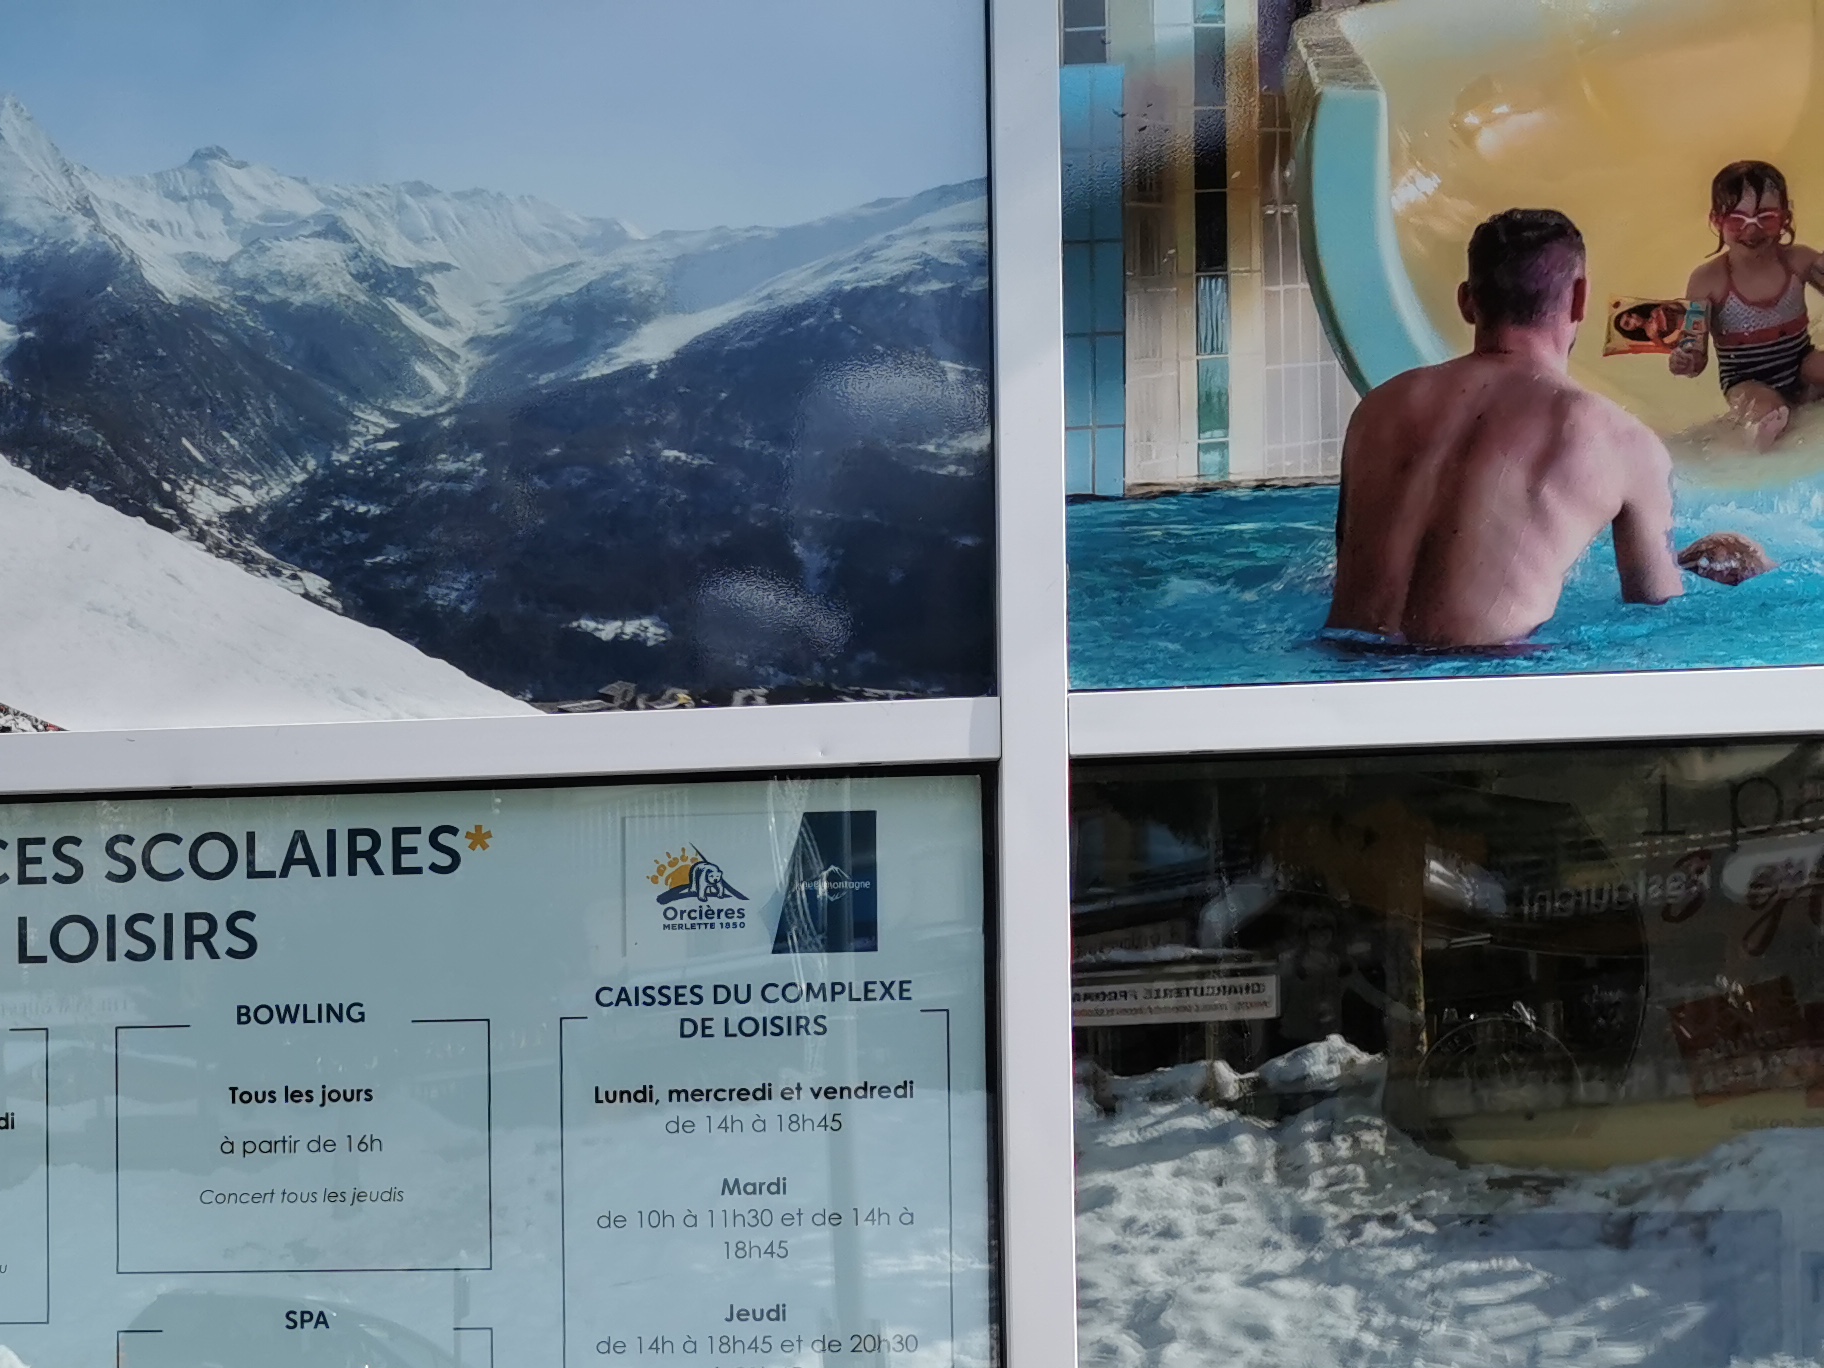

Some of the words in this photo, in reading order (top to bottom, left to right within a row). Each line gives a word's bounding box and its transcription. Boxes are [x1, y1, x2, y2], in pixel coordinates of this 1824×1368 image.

[663, 905, 746, 920] Orcières
[18, 911, 258, 964] LOISIRS
[663, 923, 716, 931] MERLETTE
[595, 984, 704, 1008] CAISSES
[713, 983, 752, 1004] DU
[761, 980, 912, 1004] COMPLEXE
[236, 1002, 366, 1025] BOWLING
[679, 1017, 715, 1038] DE
[724, 1015, 828, 1037] LOISIRS
[228, 1086, 277, 1105] Tous
[284, 1085, 314, 1104] les
[319, 1084, 374, 1107] jours
[594, 1084, 659, 1106] Lundi,
[668, 1083, 772, 1103] mercredi
[780, 1082, 802, 1101] et
[810, 1080, 914, 1100] vendredi
[665, 1115, 696, 1134] de
[706, 1114, 743, 1133] 14h
[751, 1113, 766, 1133] à
[777, 1113, 842, 1132] 18h45
[220, 1135, 234, 1155] à
[242, 1136, 300, 1158] partir
[307, 1134, 336, 1154] de
[347, 1133, 383, 1153] 16h
[199, 1188, 276, 1205] Concert
[281, 1188, 318, 1204] tous
[323, 1187, 347, 1204] les
[350, 1186, 404, 1206] jeudis
[721, 1177, 787, 1196] Mardi
[597, 1210, 627, 1229] de
[637, 1209, 675, 1228] 10h
[683, 1209, 697, 1228] à
[708, 1208, 773, 1228] 11h30
[781, 1208, 804, 1227] et
[811, 1207, 842, 1227] de
[852, 1207, 890, 1227] 14h
[898, 1206, 914, 1226] à
[724, 1240, 789, 1259] 18h45
[285, 1310, 330, 1330] SPA
[724, 1304, 787, 1322] Jeudi
